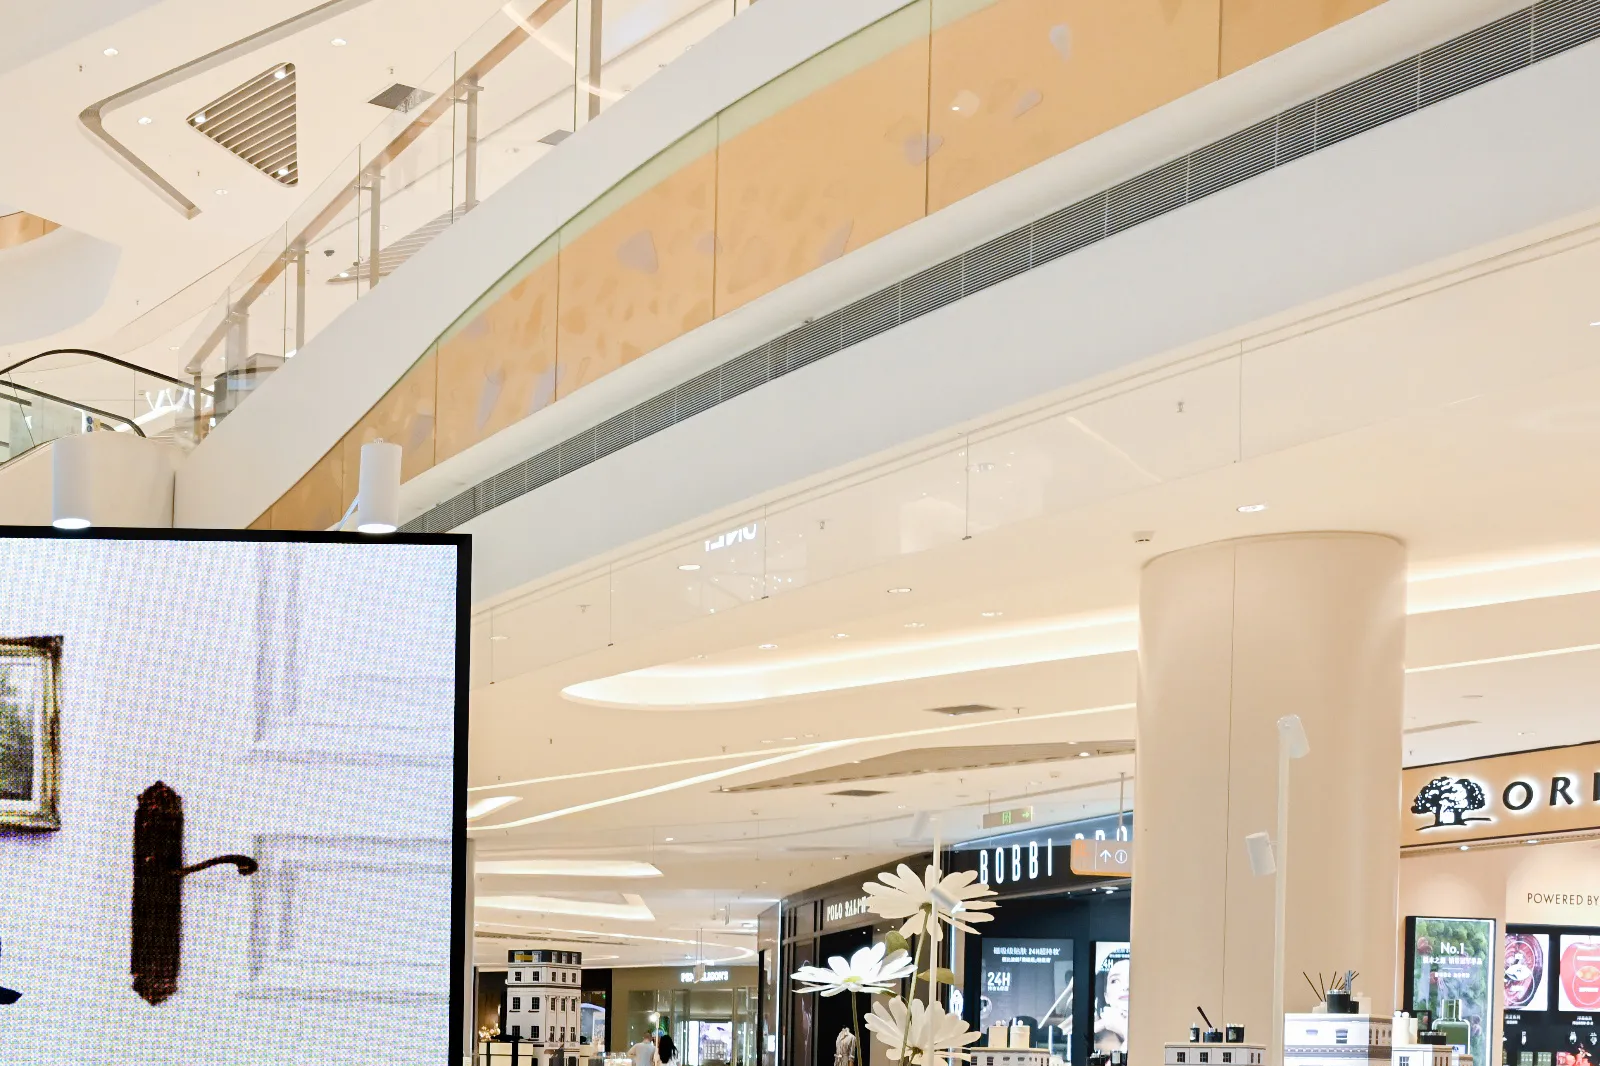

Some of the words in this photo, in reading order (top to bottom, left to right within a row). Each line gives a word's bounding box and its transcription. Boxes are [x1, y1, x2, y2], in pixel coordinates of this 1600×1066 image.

[979, 837, 1053, 885] BOBBI
[1527, 892, 1584, 906] POWERED
[1587, 895, 1600, 906] BY
[827, 902, 843, 922] POLO
[1440, 941, 1465, 955] No.1
[987, 971, 1011, 986] 24H
